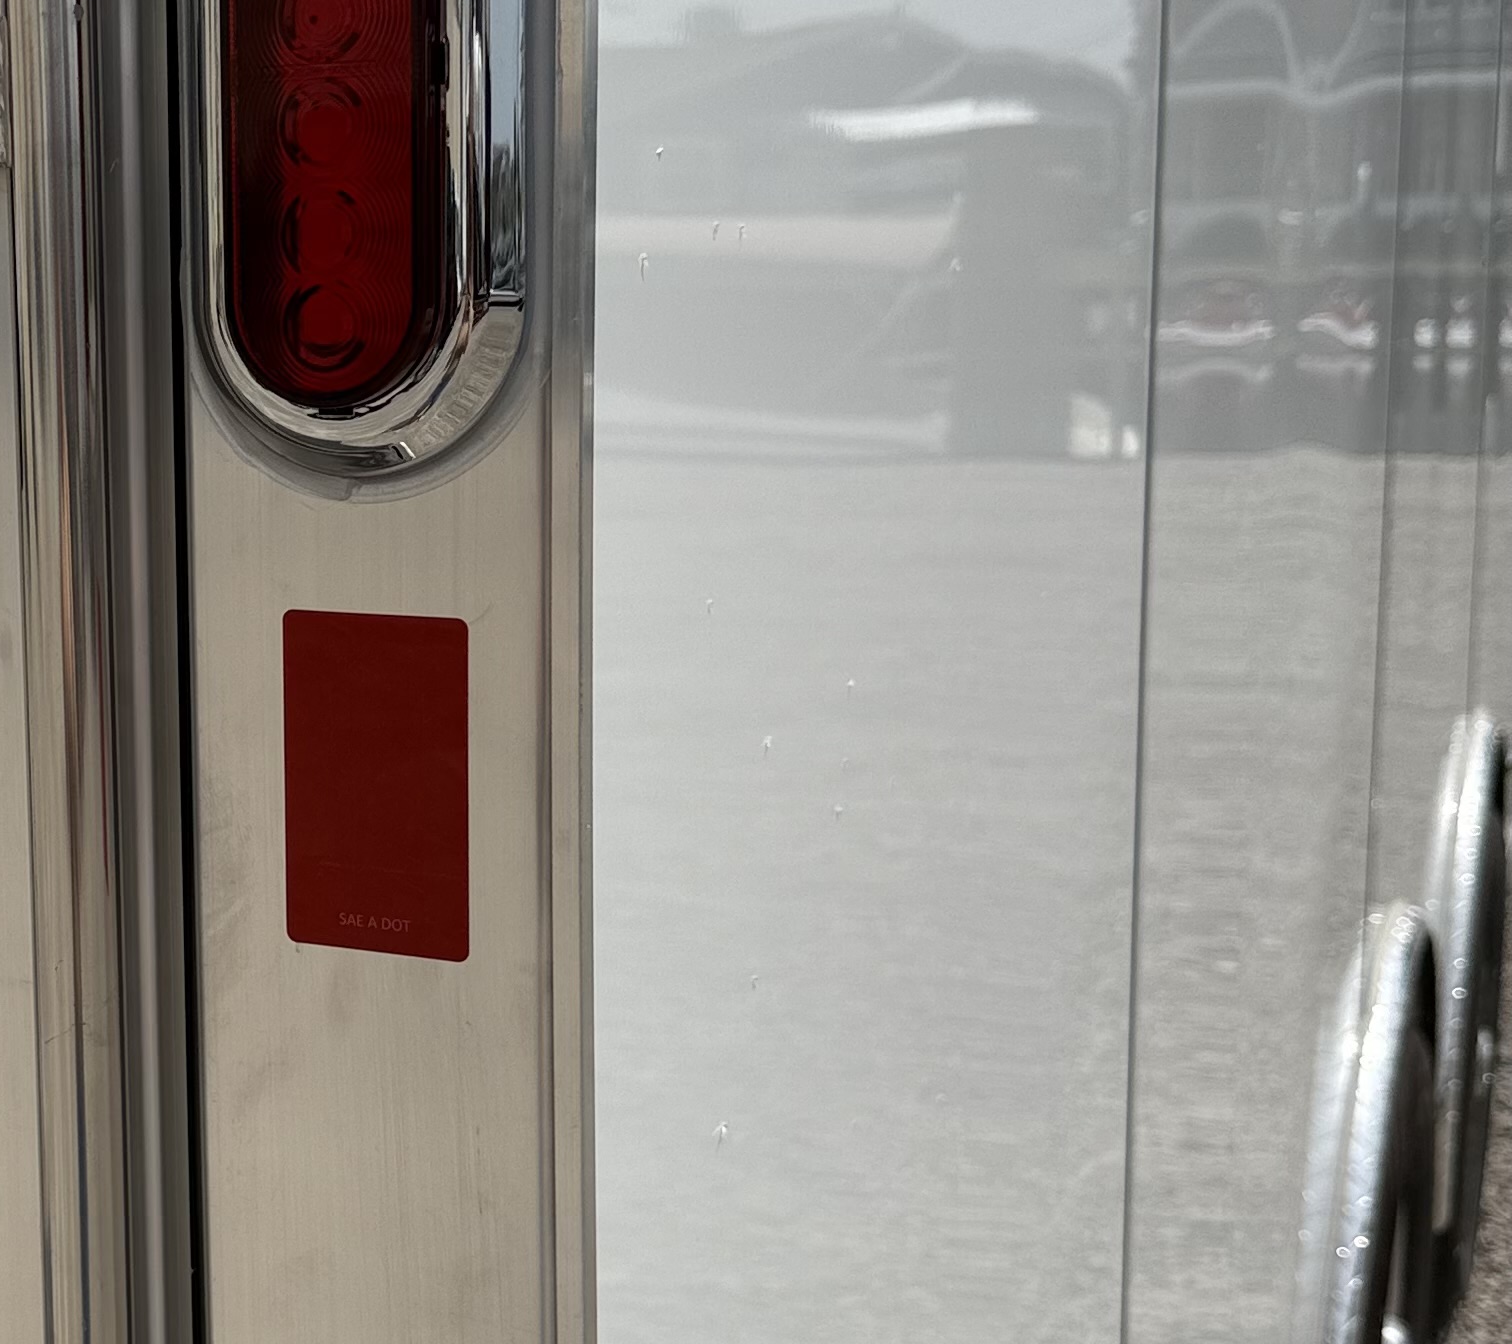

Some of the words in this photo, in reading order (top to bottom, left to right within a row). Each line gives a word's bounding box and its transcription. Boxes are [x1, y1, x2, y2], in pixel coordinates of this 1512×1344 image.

[339, 912, 364, 928] SAE
[368, 916, 378, 929] A
[381, 917, 411, 933] DOT
